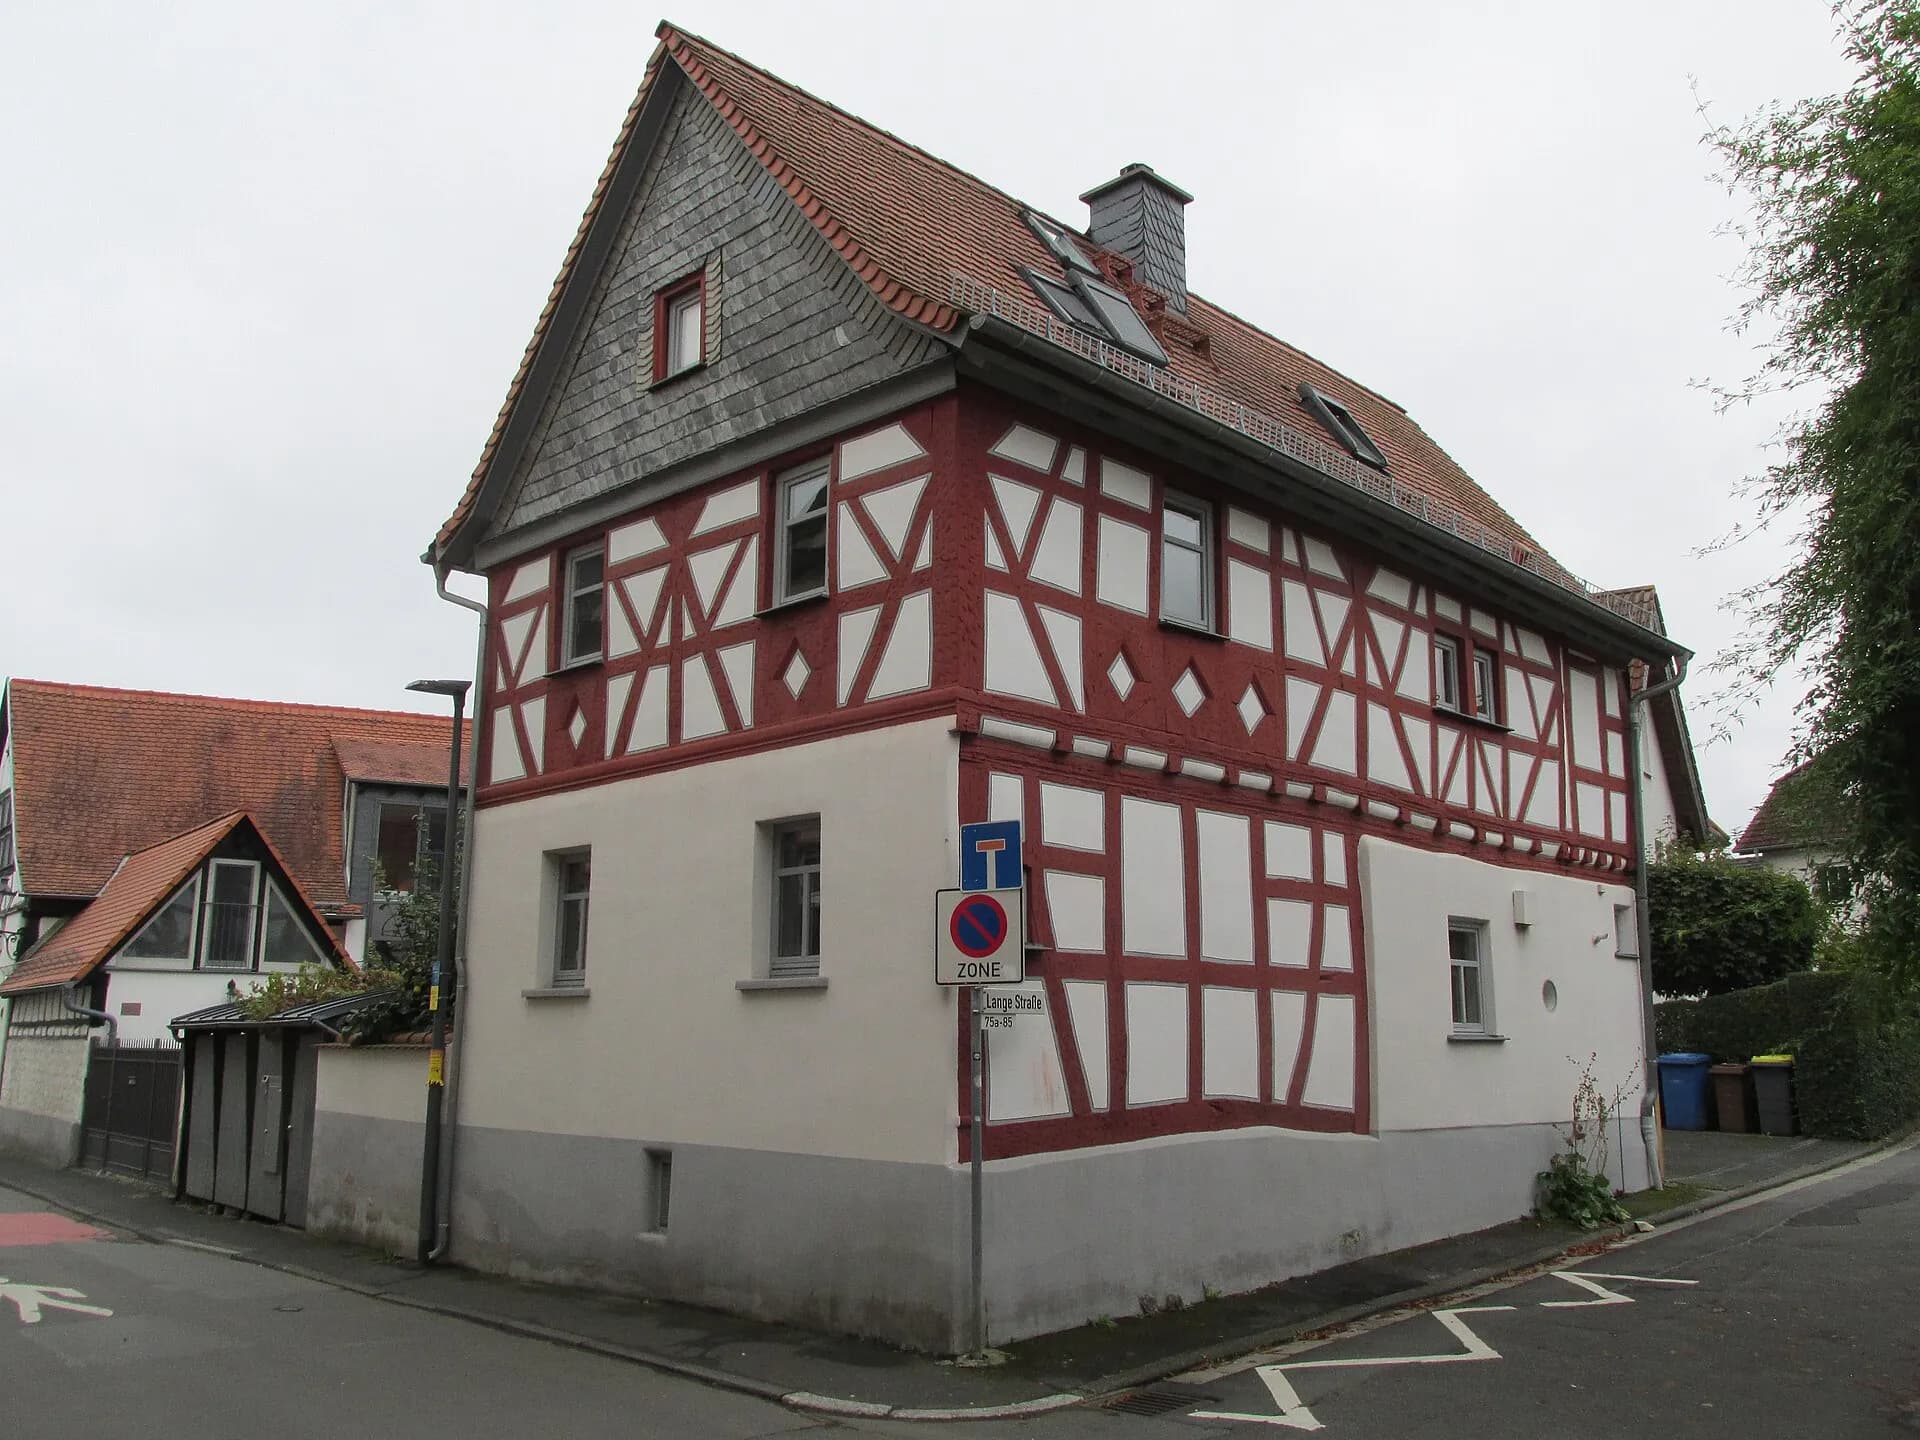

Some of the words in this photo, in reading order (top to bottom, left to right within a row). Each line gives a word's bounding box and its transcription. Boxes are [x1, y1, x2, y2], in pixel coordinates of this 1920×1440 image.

[957, 962, 1001, 978] ZONE
[986, 992, 1013, 1013] Lange
[1014, 994, 1042, 1010] Straße
[984, 1016, 1013, 1028] 75a-85
